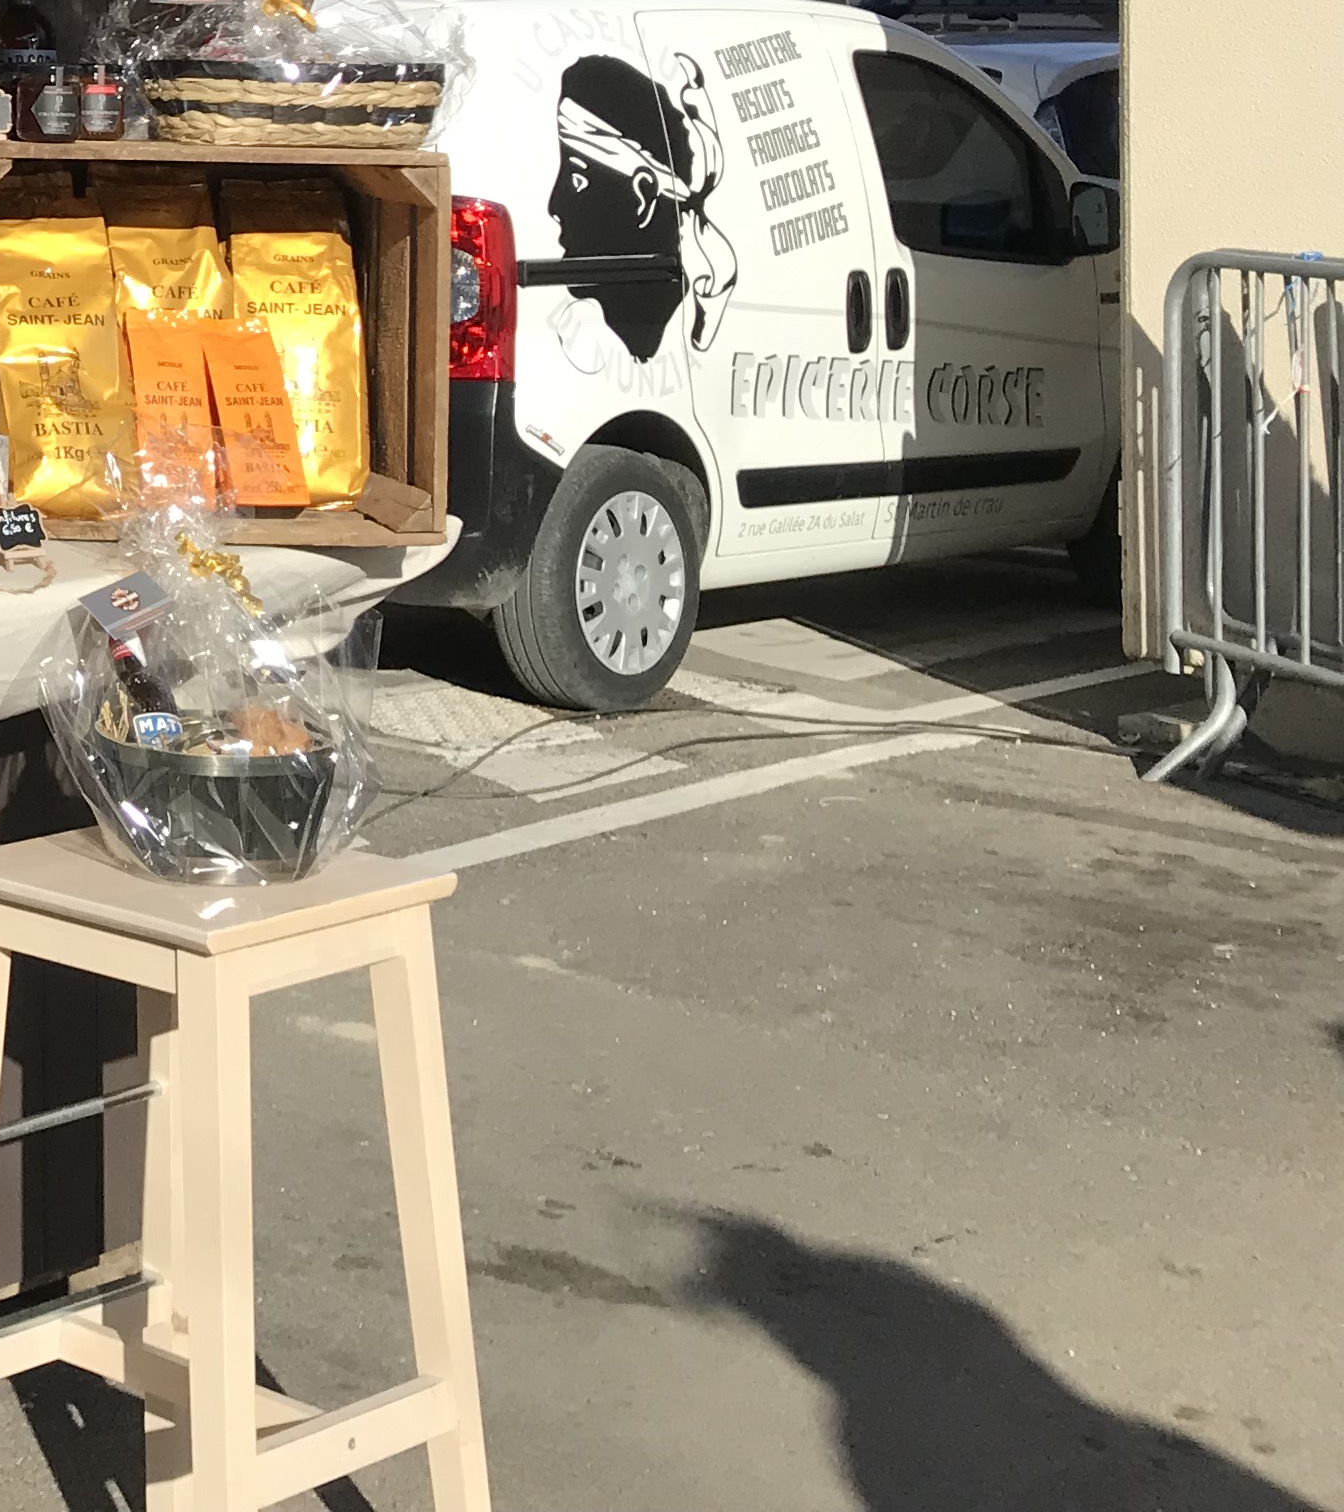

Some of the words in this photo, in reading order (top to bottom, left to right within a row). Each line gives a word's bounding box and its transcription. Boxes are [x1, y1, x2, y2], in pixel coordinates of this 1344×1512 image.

[714, 30, 802, 80] CHARCUTERIE
[731, 78, 796, 124] BISCUITS
[746, 117, 821, 168] FROMAGES
[759, 160, 836, 212] CHOCOLATS
[769, 202, 849, 257] CONFITURES
[152, 256, 194, 266] GRAINS
[273, 254, 315, 264] GRAINS
[30, 269, 71, 279] GRAINS
[152, 284, 198, 300] CAFÉ
[269, 279, 322, 295] CAFÉ
[27, 292, 80, 309] CAFÉ
[303, 302, 346, 317] JEAN
[63, 312, 105, 327] JEAN
[156, 380, 189, 392] CAFÉ
[235, 382, 267, 393] CAFÉ
[730, 351, 915, 423] EPICERIE
[926, 362, 1046, 428] CORSE
[144, 394, 202, 407] SAINT-JEAN
[224, 396, 284, 407] SAINT-JEAN
[33, 421, 104, 437] BASTIA
[952, 497, 970, 517] de
[972, 496, 1005, 515] crau
[23, 523, 35, 535] €
[738, 522, 747, 537] 2
[747, 523, 767, 537] rue
[768, 515, 806, 535] Galilée
[806, 514, 822, 530] ZA
[822, 512, 837, 529] du
[838, 510, 866, 528] Salat
